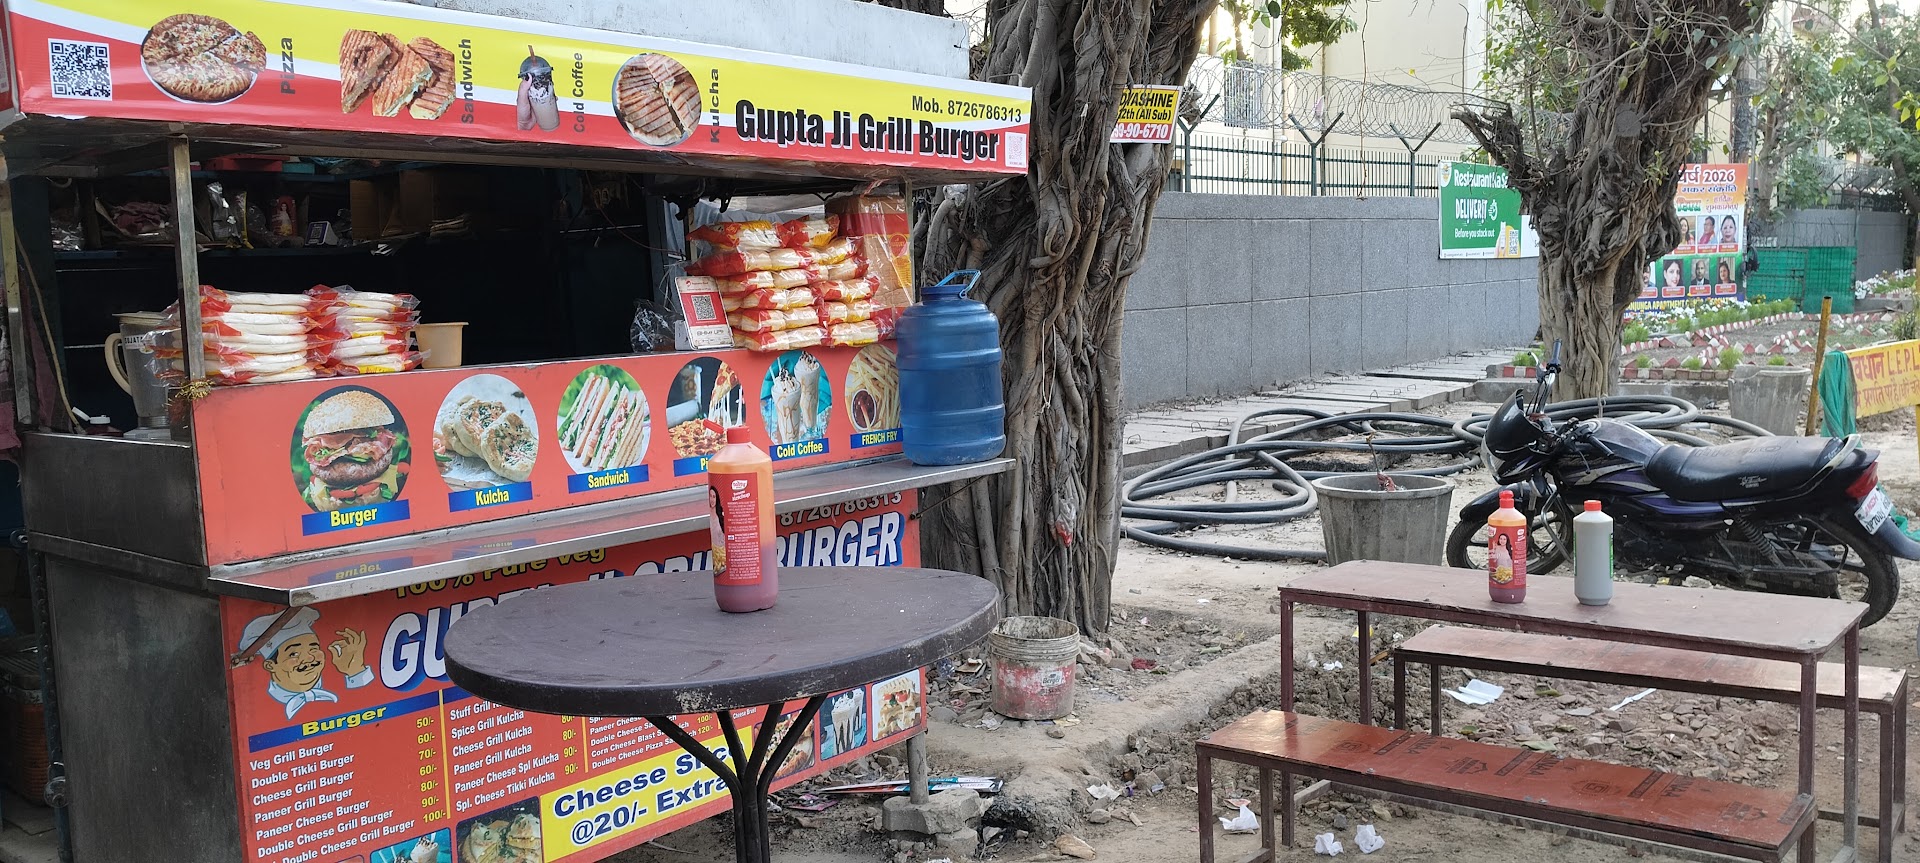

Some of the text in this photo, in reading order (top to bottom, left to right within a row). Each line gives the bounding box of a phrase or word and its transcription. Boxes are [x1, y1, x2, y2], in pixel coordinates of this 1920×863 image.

[280, 37, 294, 95] Pizza
[461, 38, 474, 124] Sandwich
[572, 52, 584, 133] Cold Coffee
[709, 68, 720, 143] Kulcha
[912, 95, 1022, 123] Mob. 8726786313
[735, 99, 999, 164] Gupta Ji Grill Burger
[1152, 110, 1171, 121] Sub)
[1454, 169, 1491, 187] Restaurant
[1704, 171, 1734, 182] 2026
[1653, 298, 1685, 309] APATMENT
[1851, 352, 1884, 381] वधान
[776, 441, 823, 458] Cold Coffee
[861, 430, 898, 446] FRENCH FRY
[475, 488, 510, 506] Kulcha
[588, 470, 630, 488] Sandwich
[330, 507, 378, 527] Burger
[780, 491, 902, 527] 8726786313
[302, 706, 387, 736] Burger
[450, 701, 490, 721] Stuff Grill
[451, 711, 524, 739] Spice Grill Kulcha
[590, 723, 614, 735] Paneer
[249, 717, 434, 771] Veg Grill Burger 50/-
[452, 742, 484, 757] Cheese
[486, 733, 503, 747] Grill
[505, 725, 532, 742] Kulcha
[453, 730, 576, 775] Paneer Grill Kulcha 80/-
[590, 735, 615, 746] Double
[616, 726, 642, 738] Cheese
[591, 748, 608, 758] Corn
[610, 739, 635, 751] Cheese
[637, 732, 655, 743] Blast
[697, 714, 712, 724] 100/-
[592, 758, 616, 769] Double
[618, 749, 644, 761] Cheese
[645, 741, 663, 751] Pizza
[698, 725, 713, 734] 120/-
[251, 732, 435, 789] Double Tikki Burger 60/-
[253, 748, 436, 806] Cheese Grill Burger 70/-
[455, 746, 577, 793] Paneer Cheese Spl Kulcha 90/-
[254, 764, 437, 823] Paneer Grill Burger 60/-
[456, 763, 578, 812] Spl. Cheese Tikki Kulcha 90/-
[553, 766, 667, 818] Cheese
[572, 774, 729, 845] @20/- Extra
[256, 780, 438, 840] Paneer Cheese Burger 80/-
[257, 796, 439, 858] Double Cheese Grill Burger 90/-
[282, 810, 446, 863] Double Cheese Grill Burger 100/-
